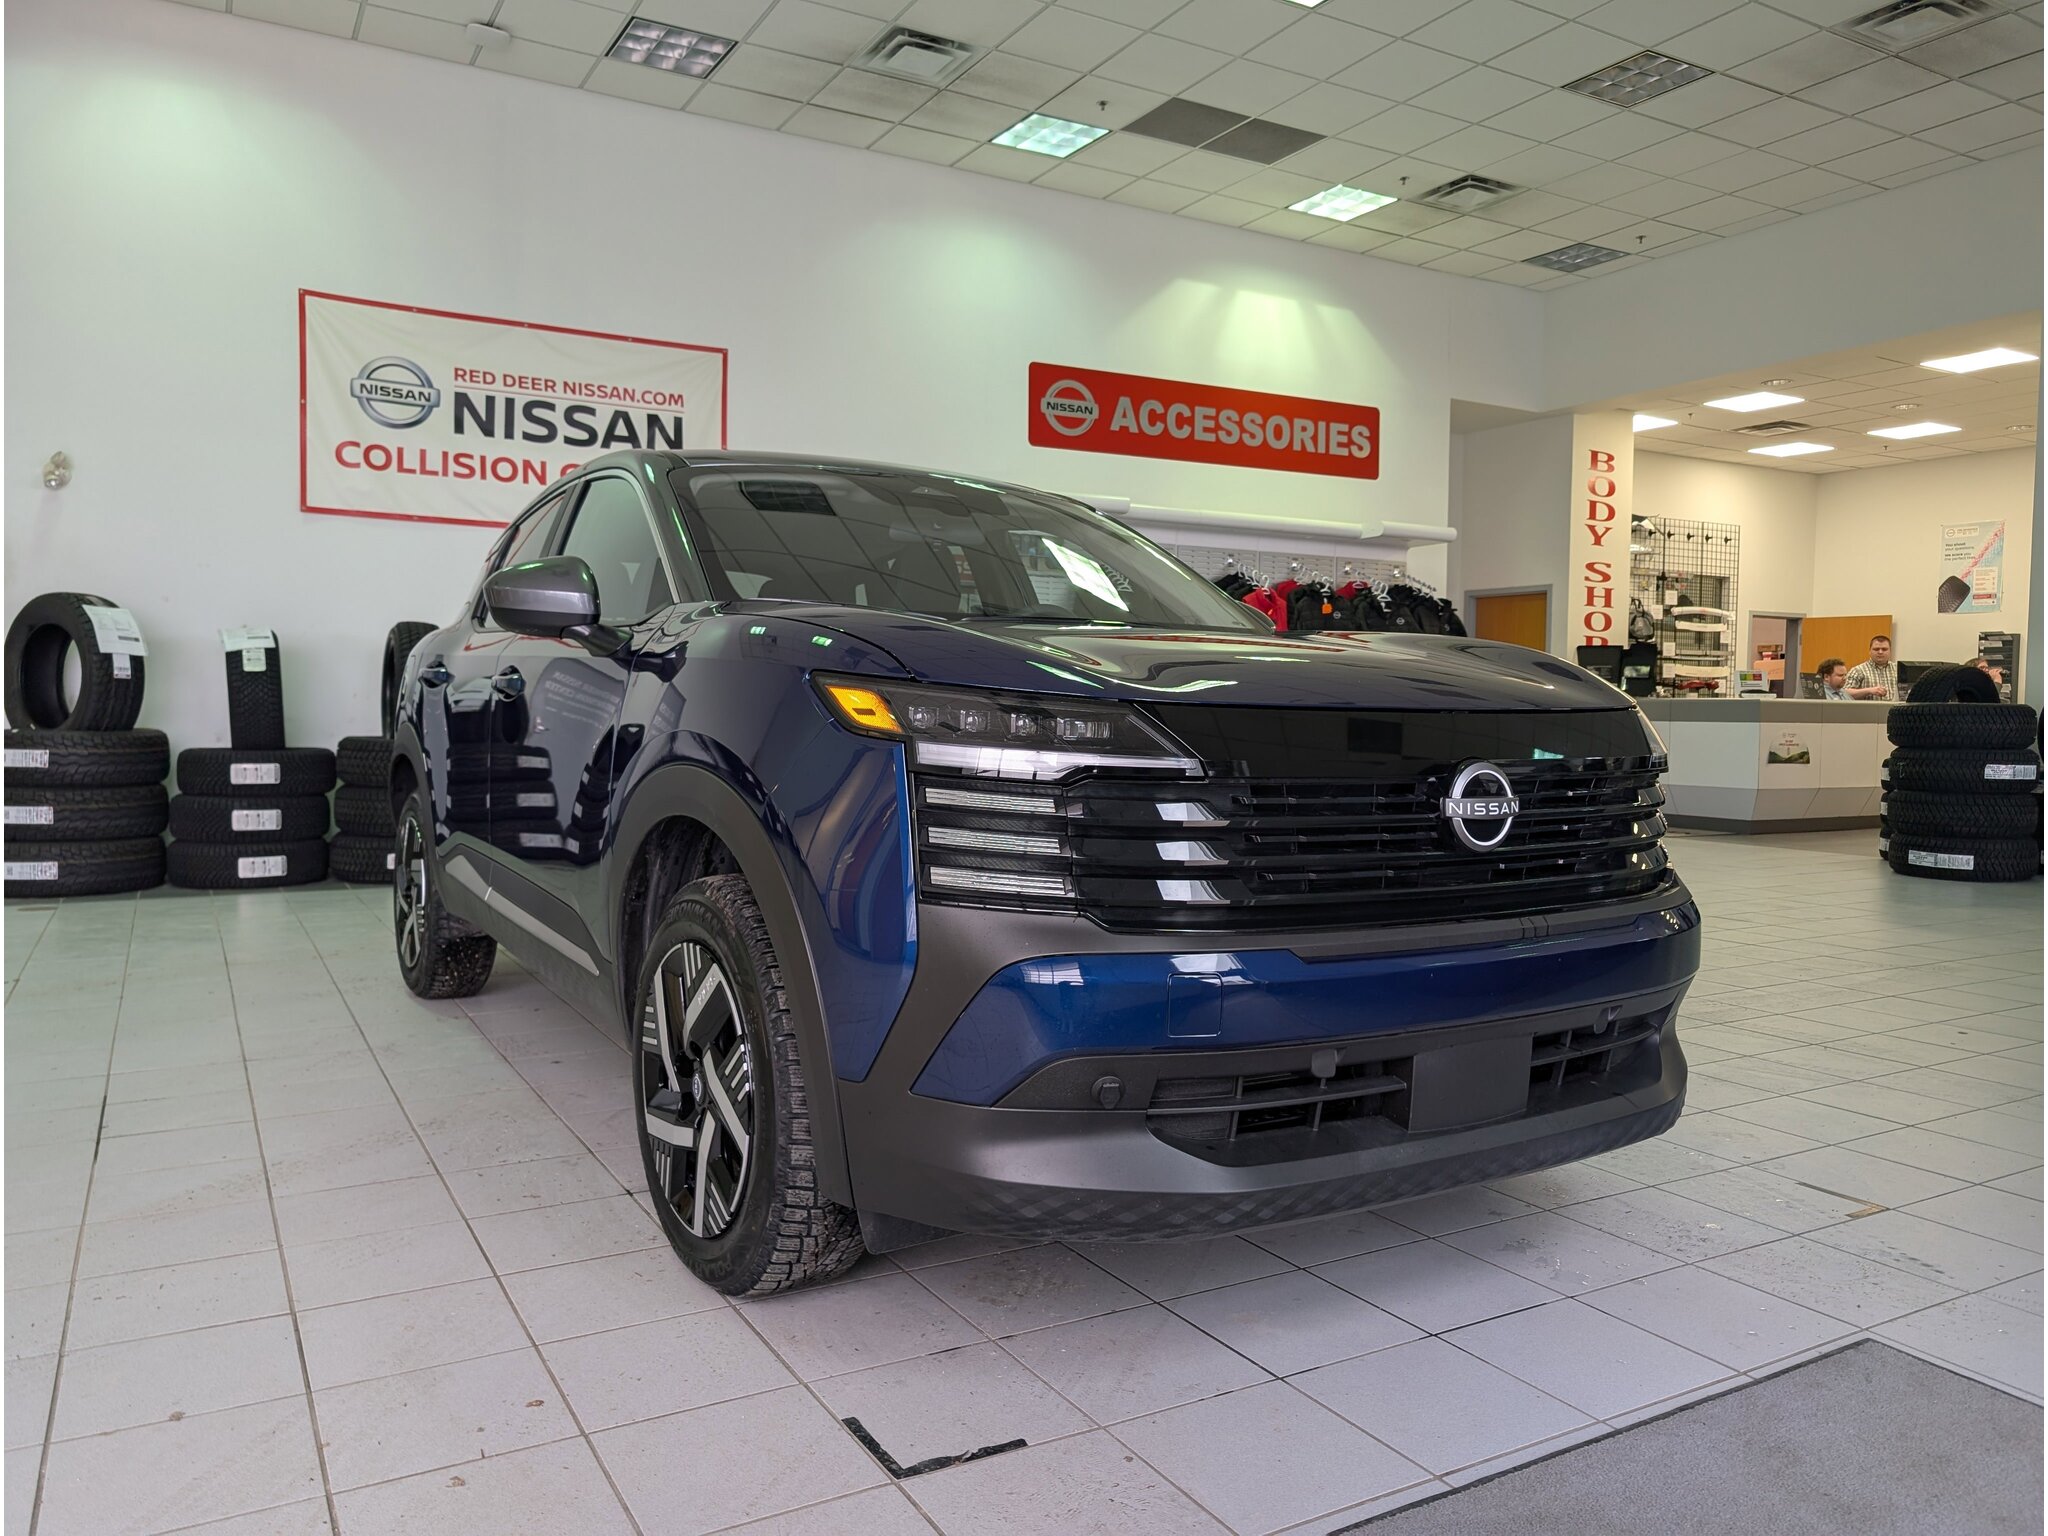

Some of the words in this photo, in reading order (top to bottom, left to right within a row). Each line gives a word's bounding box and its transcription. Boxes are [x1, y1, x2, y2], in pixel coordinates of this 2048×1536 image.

[359, 382, 432, 403] NISSAN
[453, 366, 497, 386] RED
[502, 372, 557, 393] DEER
[563, 381, 685, 409] NISSAN.COM
[1045, 400, 1094, 415] NISSAN
[453, 391, 685, 450] NISSAN
[1110, 396, 1371, 459] ACCESSORIES
[334, 440, 547, 486] COLLISION
[1584, 449, 1616, 547] BODY
[1448, 801, 1519, 815] NISSAN
